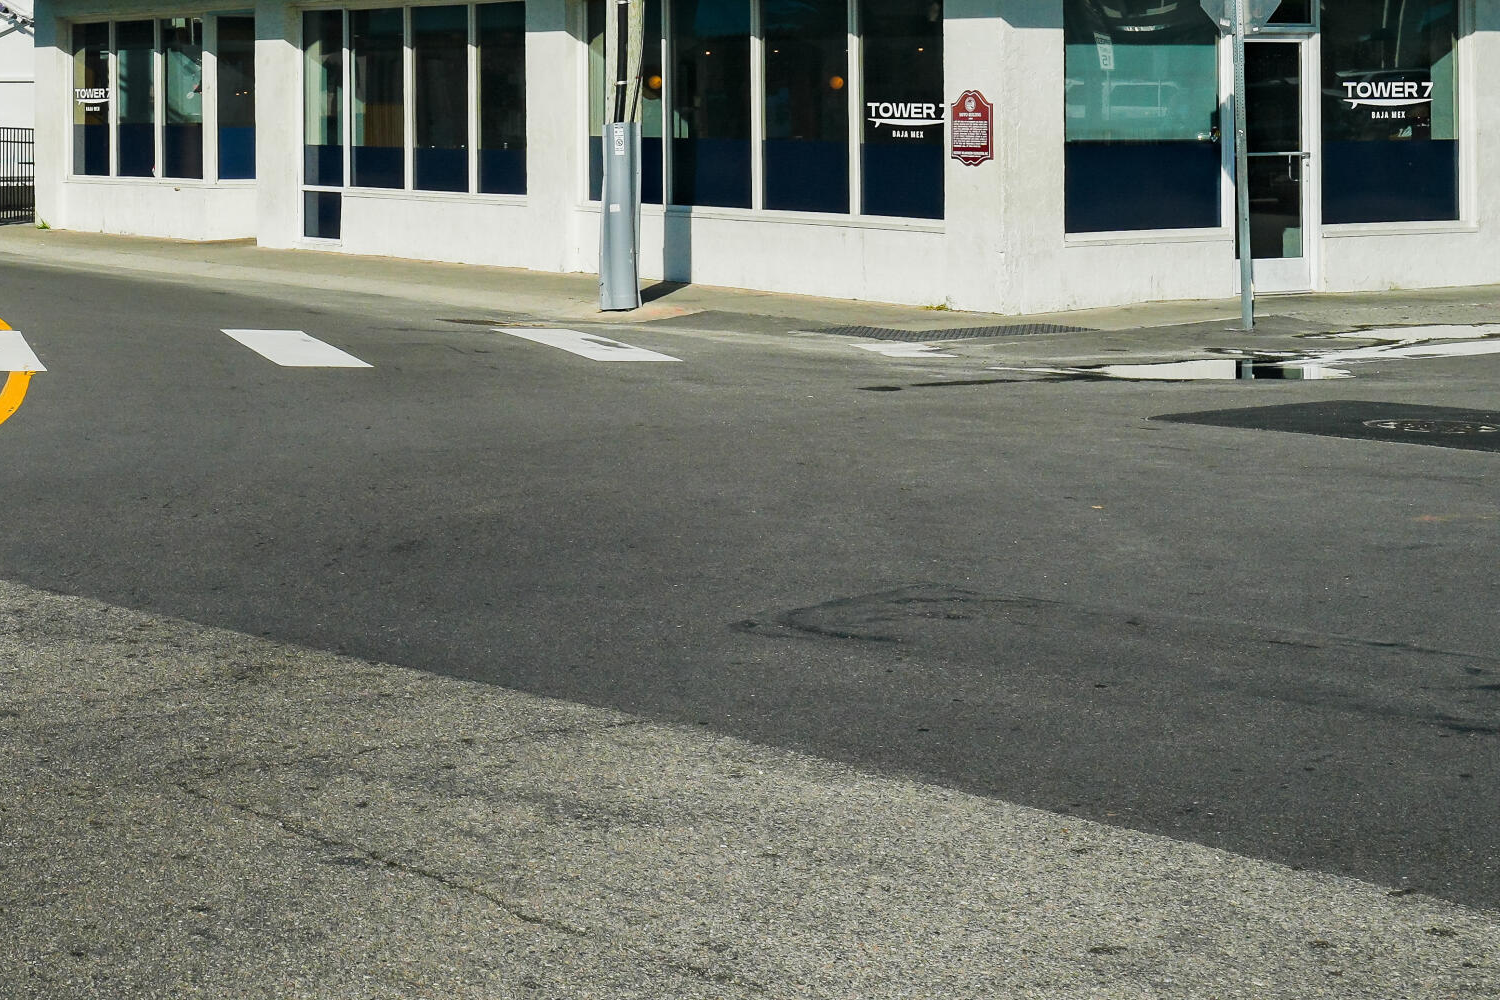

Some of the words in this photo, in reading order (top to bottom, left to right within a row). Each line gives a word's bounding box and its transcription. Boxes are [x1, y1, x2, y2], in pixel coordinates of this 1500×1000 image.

[74, 88, 105, 99] TOWER
[1342, 81, 1418, 98] TOWER
[1421, 81, 1434, 98] 7
[867, 102, 936, 118] TOWER
[1371, 111, 1389, 119] BAJA
[1391, 111, 1406, 119] MEX
[892, 130, 909, 138] BAJA
[910, 130, 924, 138] MEX
